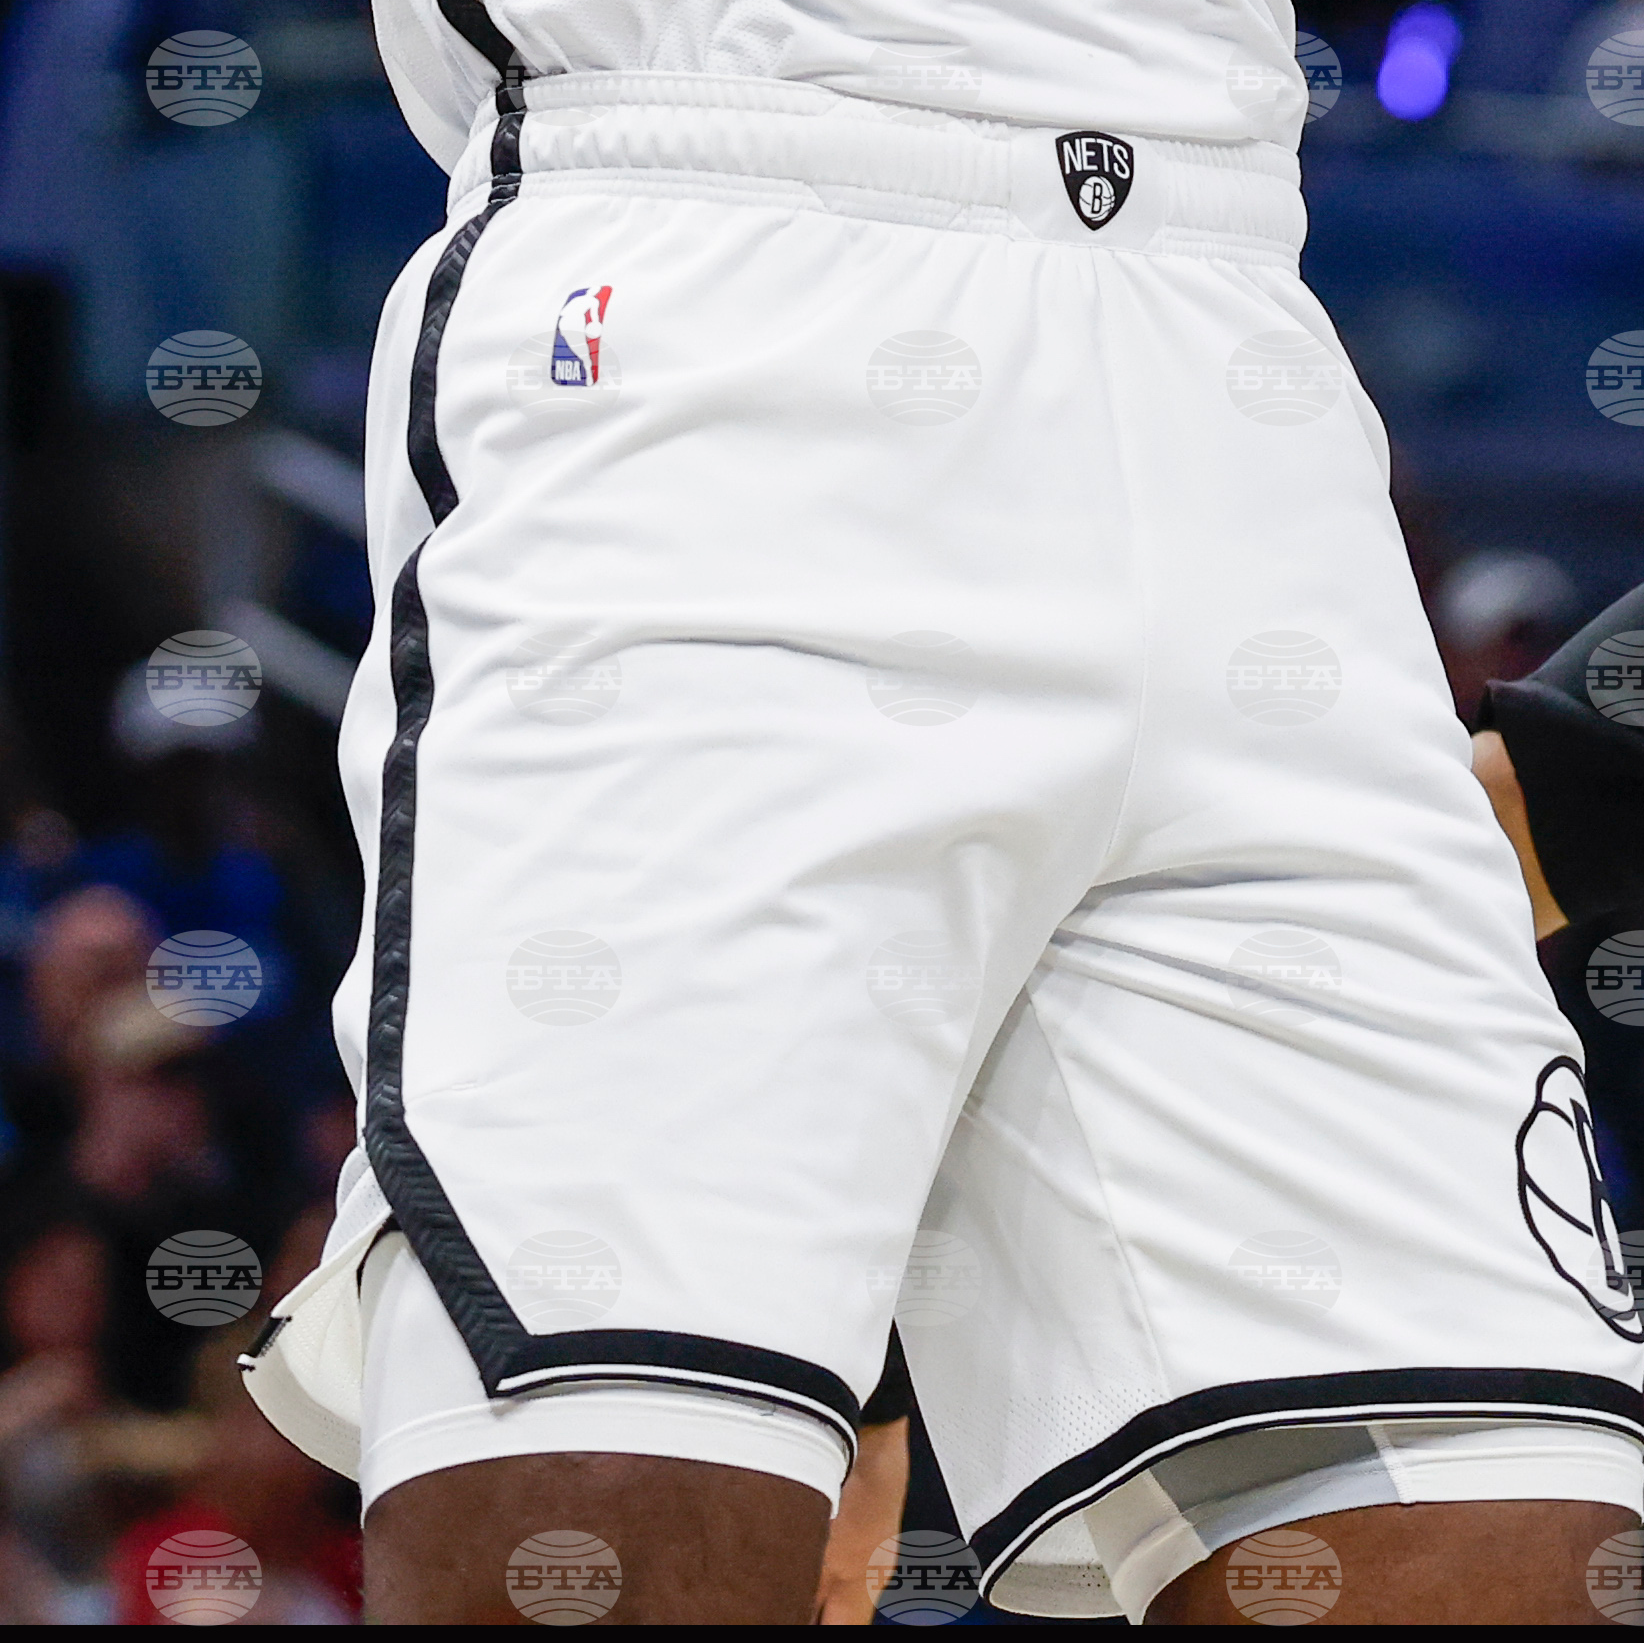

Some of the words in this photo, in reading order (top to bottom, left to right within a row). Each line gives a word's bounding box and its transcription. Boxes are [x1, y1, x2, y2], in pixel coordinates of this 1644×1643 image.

[1062, 137, 1131, 180] NETS
[1090, 182, 1104, 214] B
[554, 359, 582, 382] NBA
